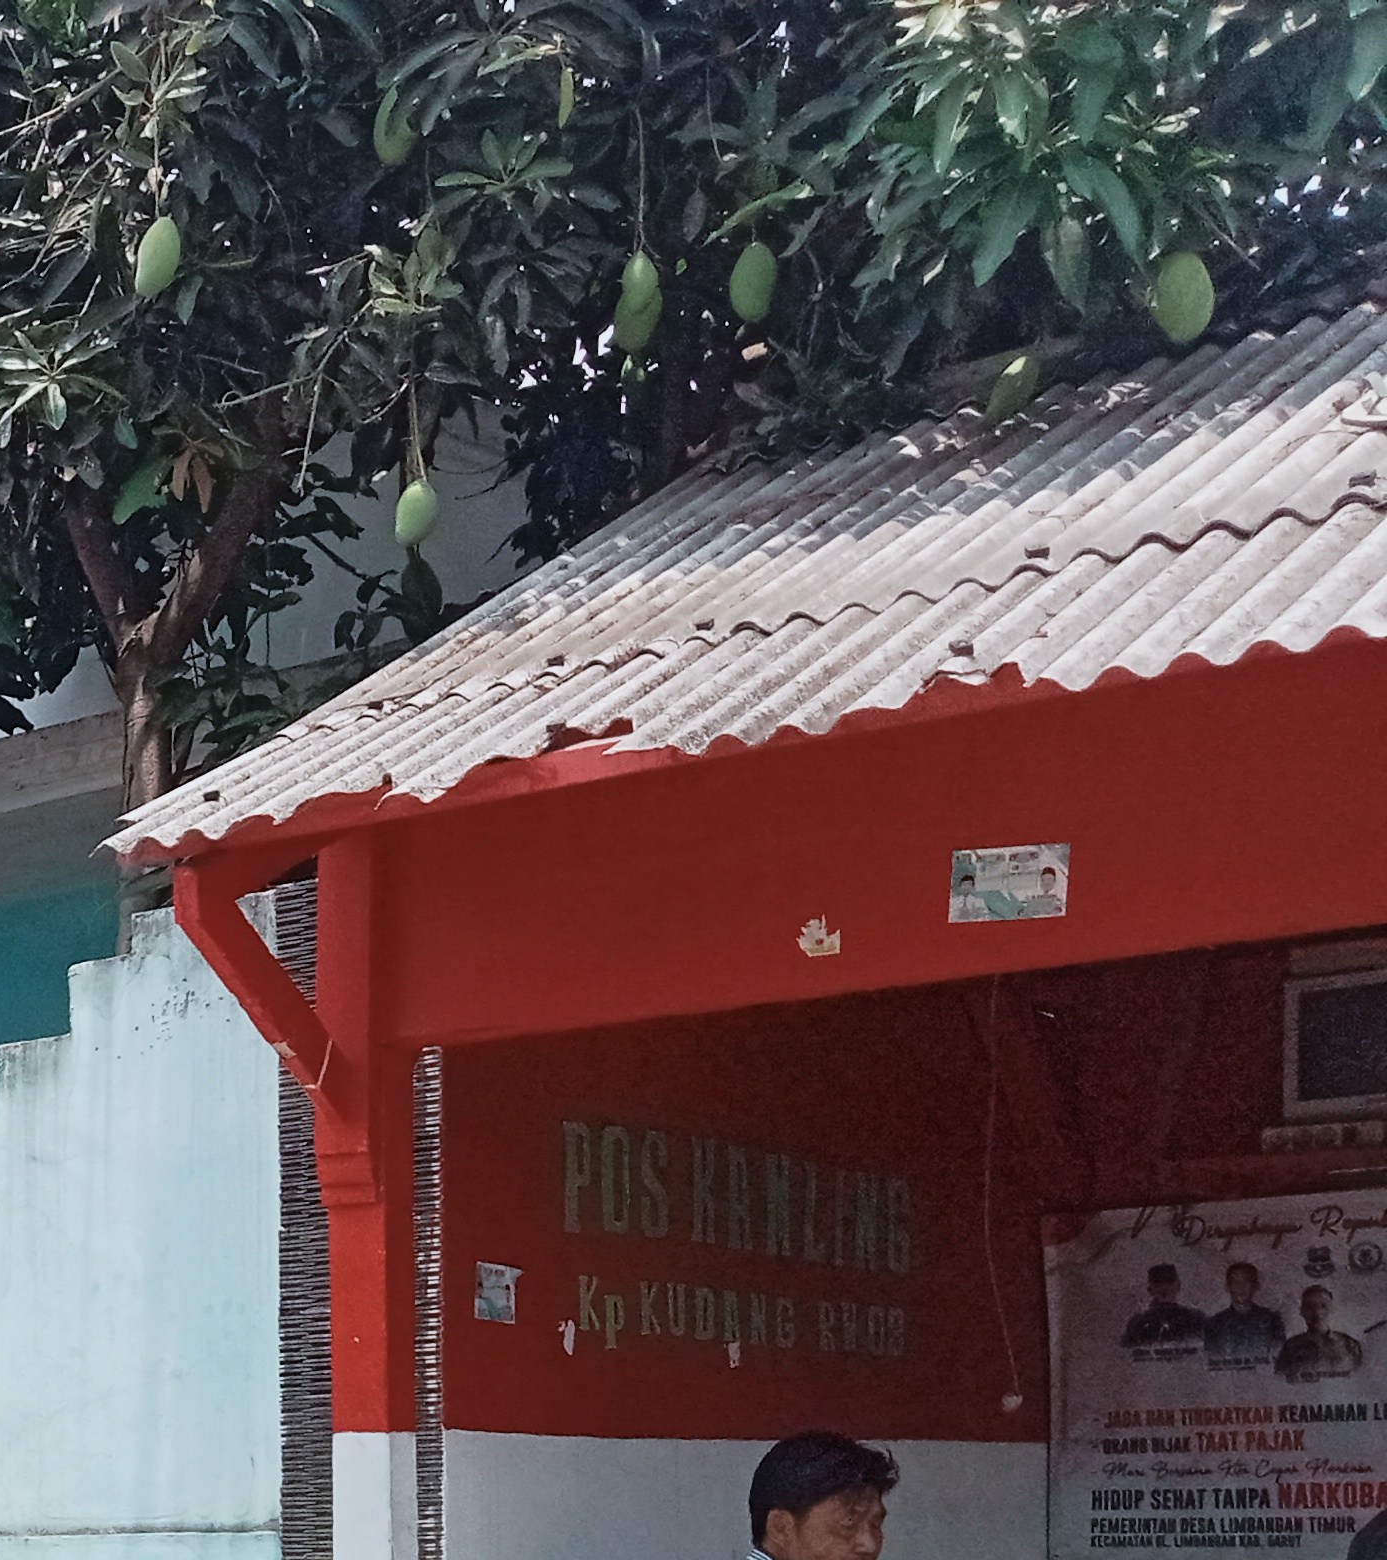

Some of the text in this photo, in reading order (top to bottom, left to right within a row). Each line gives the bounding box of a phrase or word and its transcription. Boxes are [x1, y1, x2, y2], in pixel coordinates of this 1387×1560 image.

[562, 1120, 670, 1239] POS
[578, 1275, 624, 1350] Kp
[1278, 1403, 1367, 1423] KEAMANAN
[1195, 1430, 1238, 1453] TAAT
[1245, 1428, 1305, 1452] PAJAK
[1091, 1481, 1387, 1511] HIDUP SEHAT TANPA NARKOBA
[1090, 1516, 1356, 1534] PEMERINTAH DESA LIMBANGAN TIMUR
[1090, 1535, 1153, 1548] KECAMATAN
